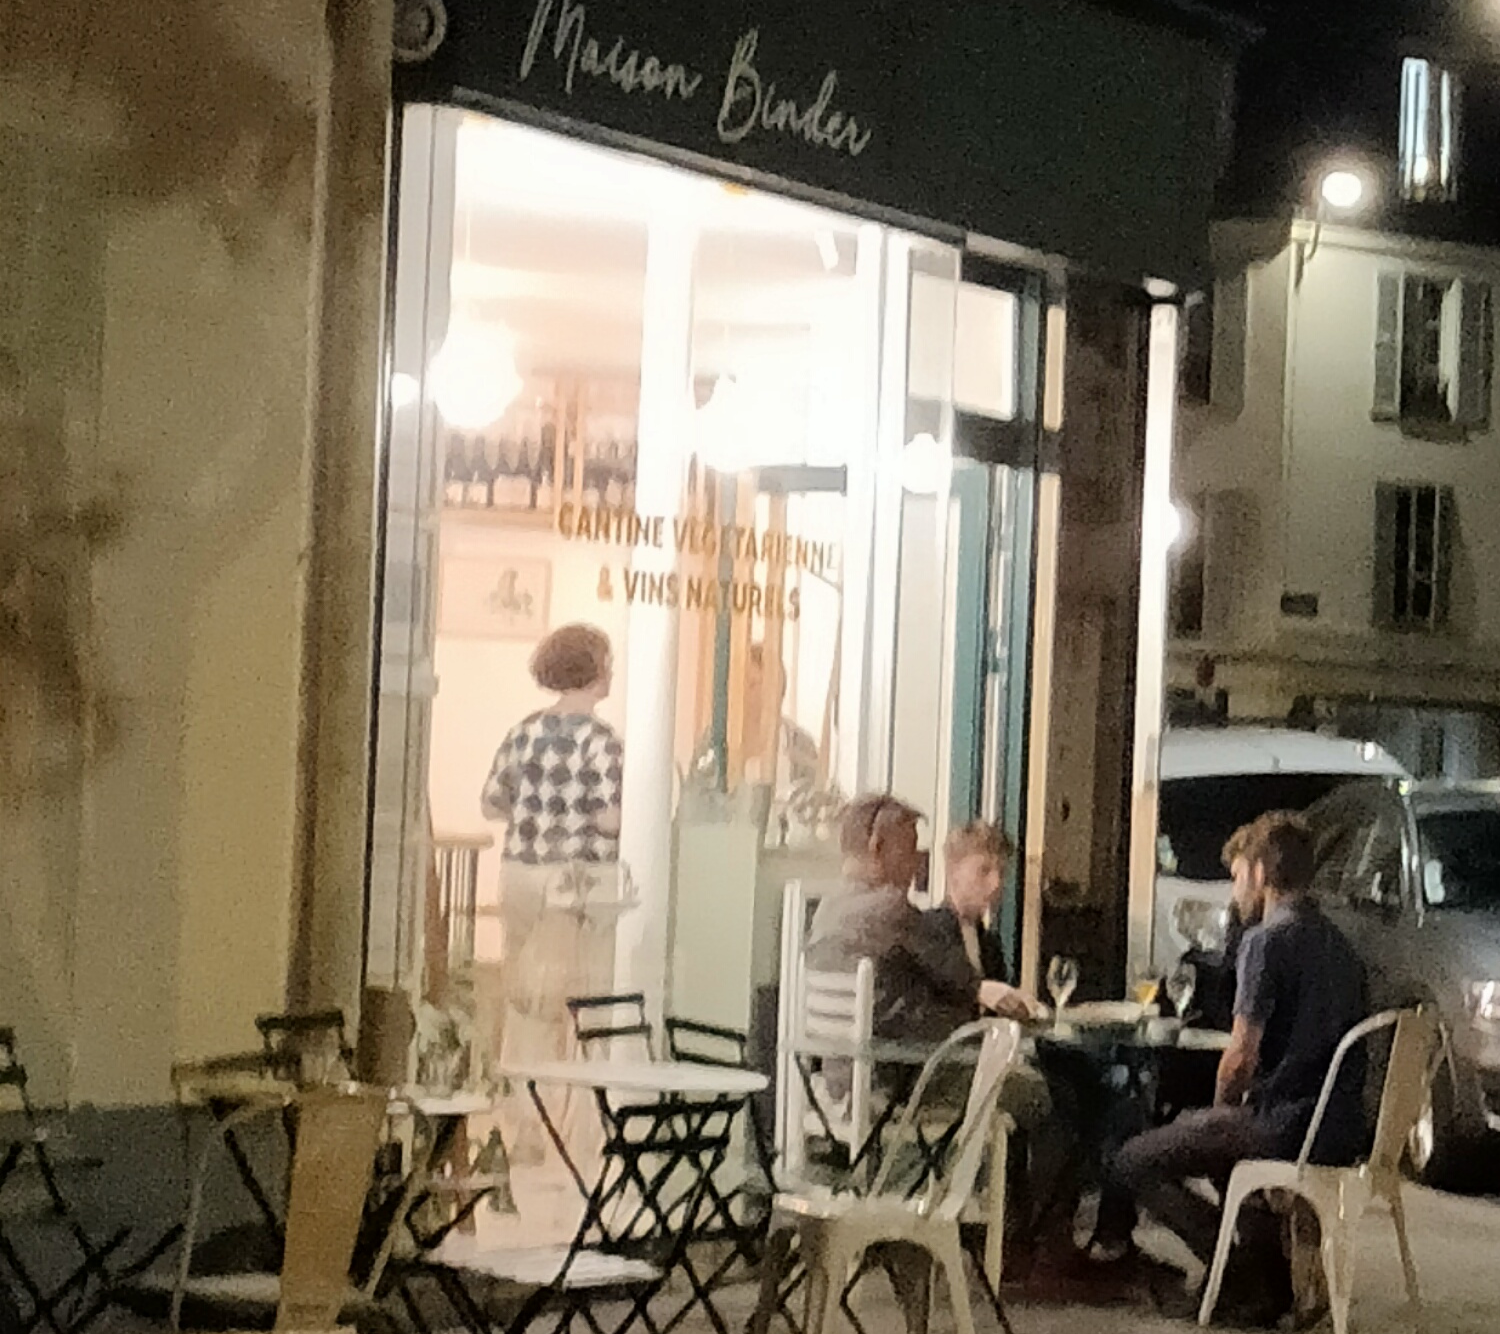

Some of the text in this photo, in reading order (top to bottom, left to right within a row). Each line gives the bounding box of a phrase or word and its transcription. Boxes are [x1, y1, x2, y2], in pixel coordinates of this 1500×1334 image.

[716, 26, 872, 156] Binder
[557, 501, 665, 549] CANTINE
[623, 566, 680, 608] VINS
